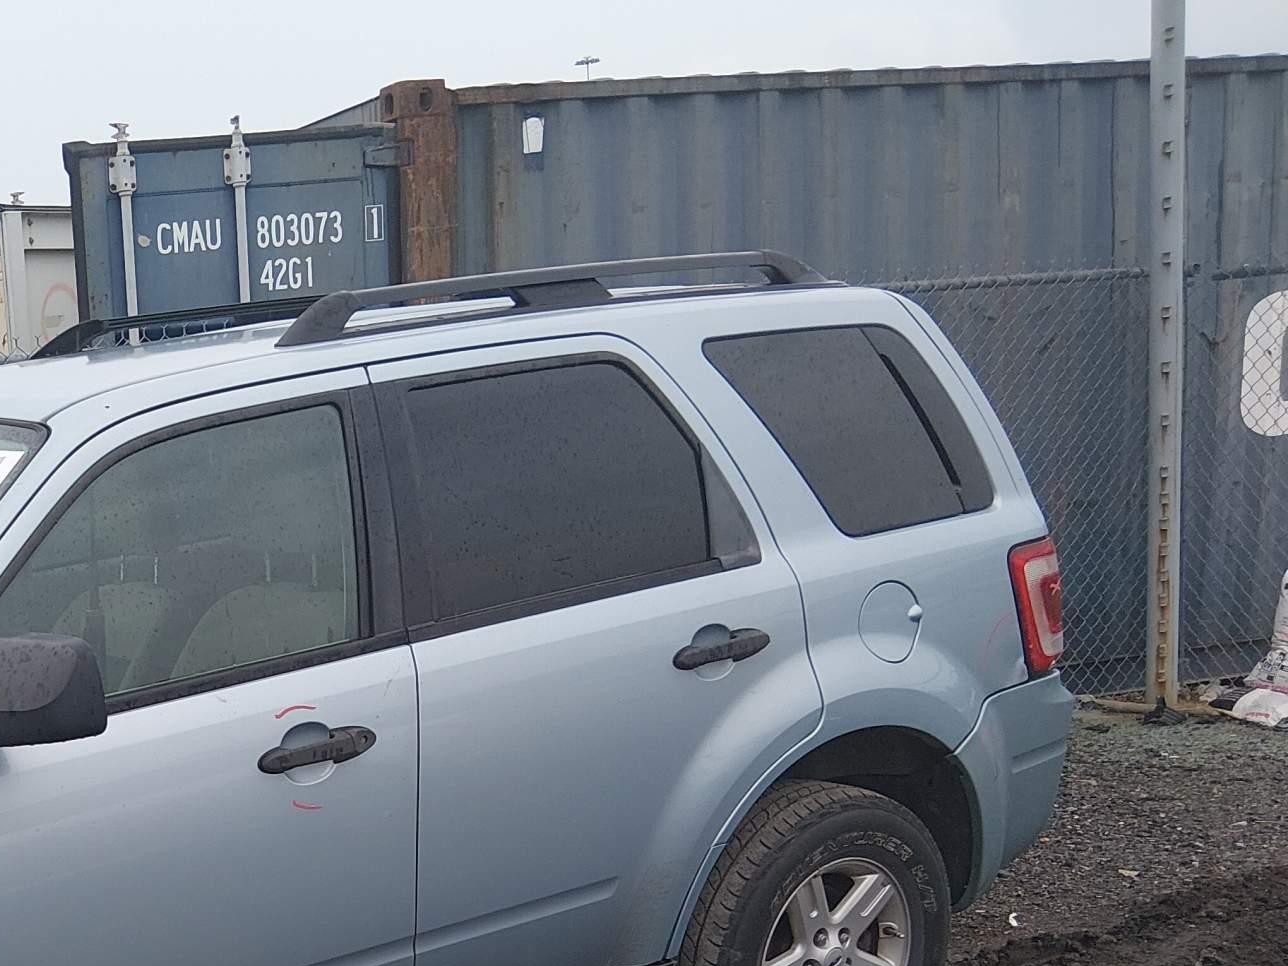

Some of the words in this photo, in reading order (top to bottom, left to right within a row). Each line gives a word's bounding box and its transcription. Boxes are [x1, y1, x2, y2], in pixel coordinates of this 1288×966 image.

[156, 219, 222, 255] CMAU
[256, 211, 344, 249] 803073
[369, 207, 380, 240] 1
[260, 257, 314, 291] 42G1
